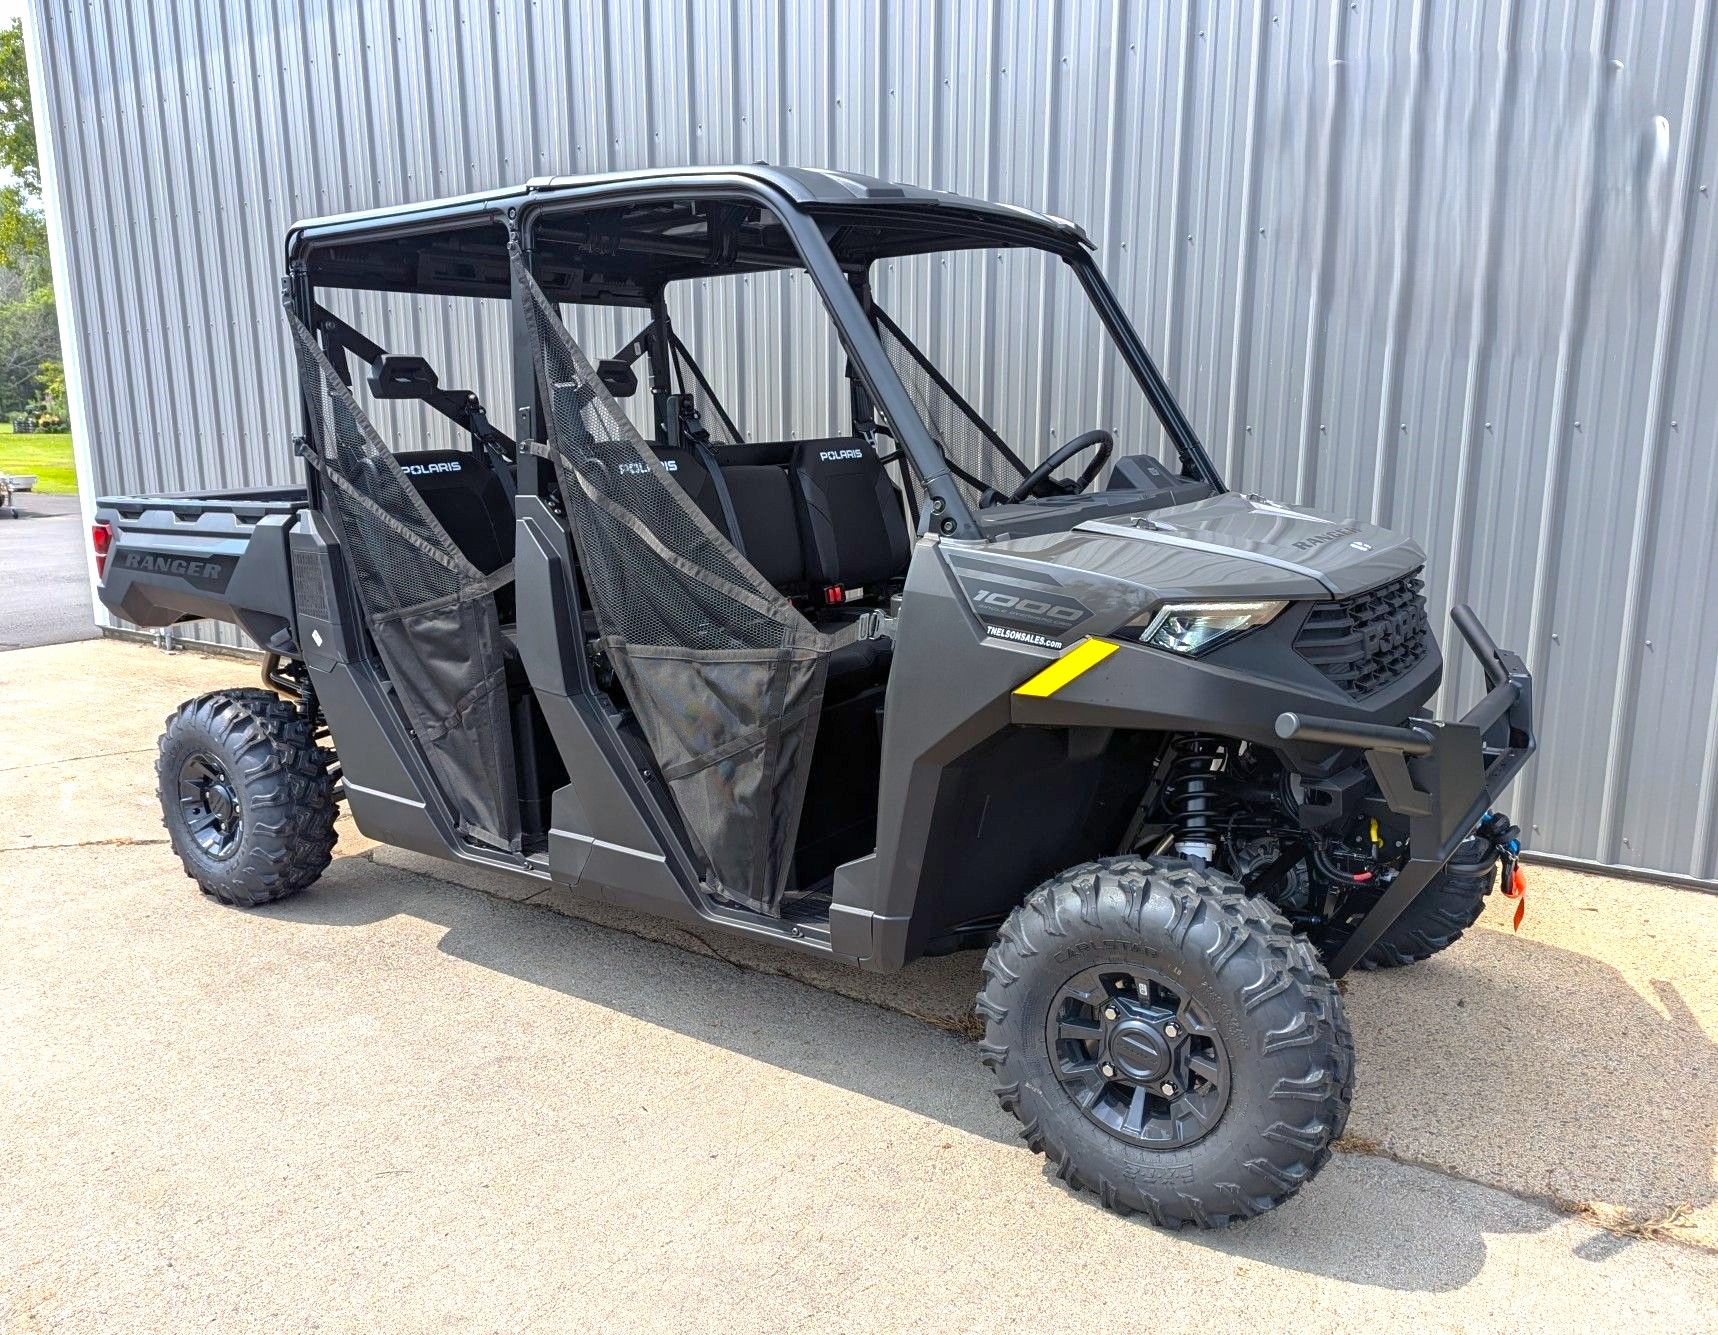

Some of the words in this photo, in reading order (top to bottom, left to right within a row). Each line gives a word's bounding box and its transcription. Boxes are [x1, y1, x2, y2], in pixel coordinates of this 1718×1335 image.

[820, 449, 862, 461] POLARIS
[401, 462, 462, 475] POLARIS
[618, 460, 678, 475] POLIS
[1292, 527, 1361, 551] RANGER
[125, 553, 222, 579] RANGER
[973, 589, 1084, 621] 1000
[986, 625, 1063, 649] TNELSONSALES.com
